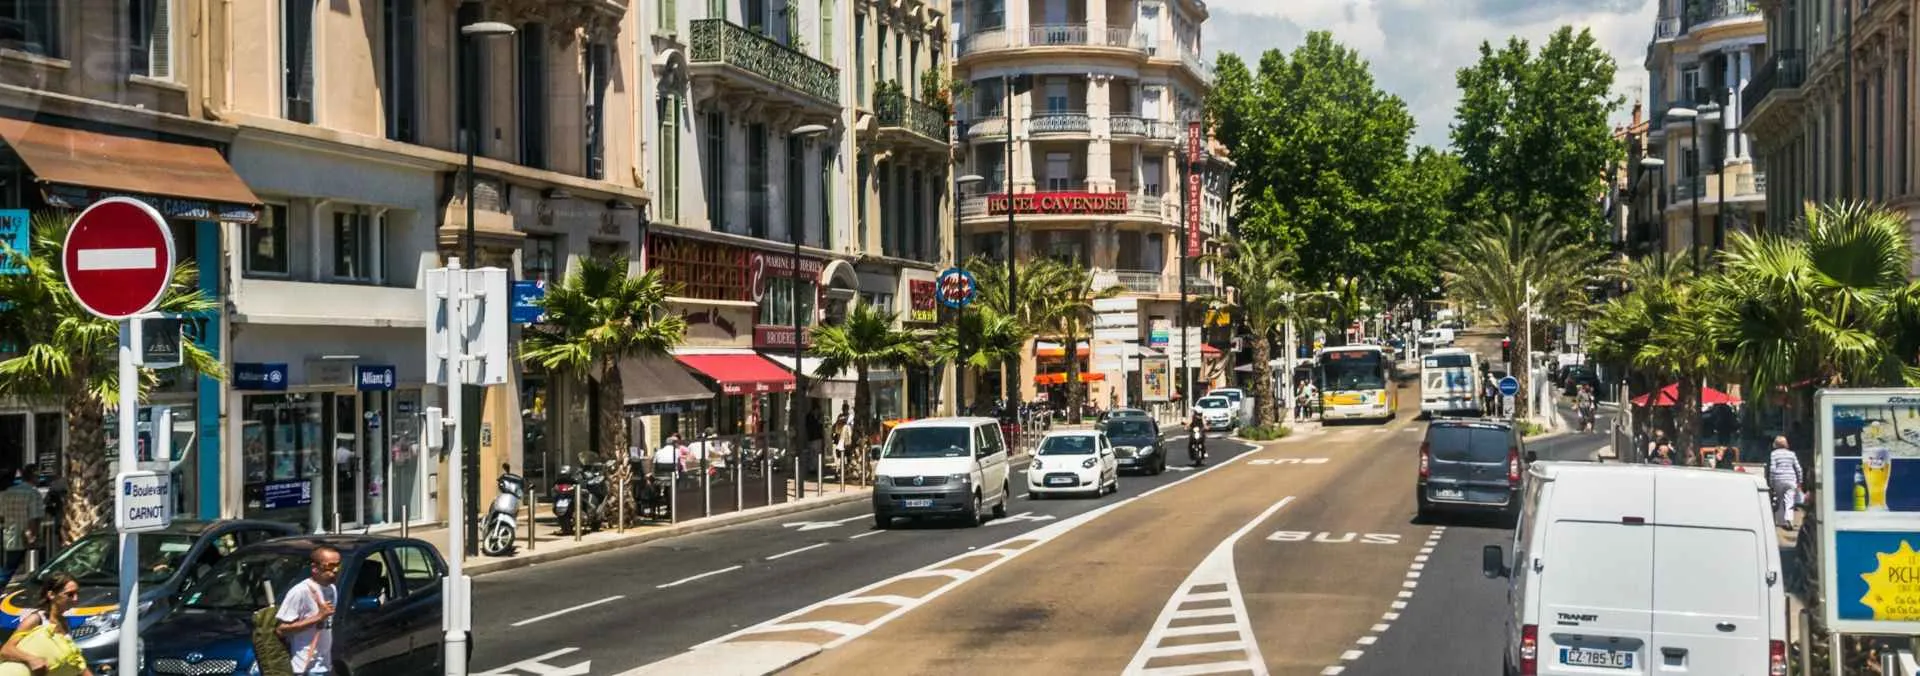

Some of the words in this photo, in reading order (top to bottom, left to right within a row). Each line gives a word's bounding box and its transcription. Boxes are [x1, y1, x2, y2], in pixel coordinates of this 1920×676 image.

[991, 196, 1039, 211] HOTEL
[1041, 196, 1126, 211] CAVENDISH
[362, 371, 384, 385] Allianz
[133, 482, 168, 498] Boulevard
[129, 505, 164, 520] CARNOT
[1265, 530, 1401, 545] BUS
